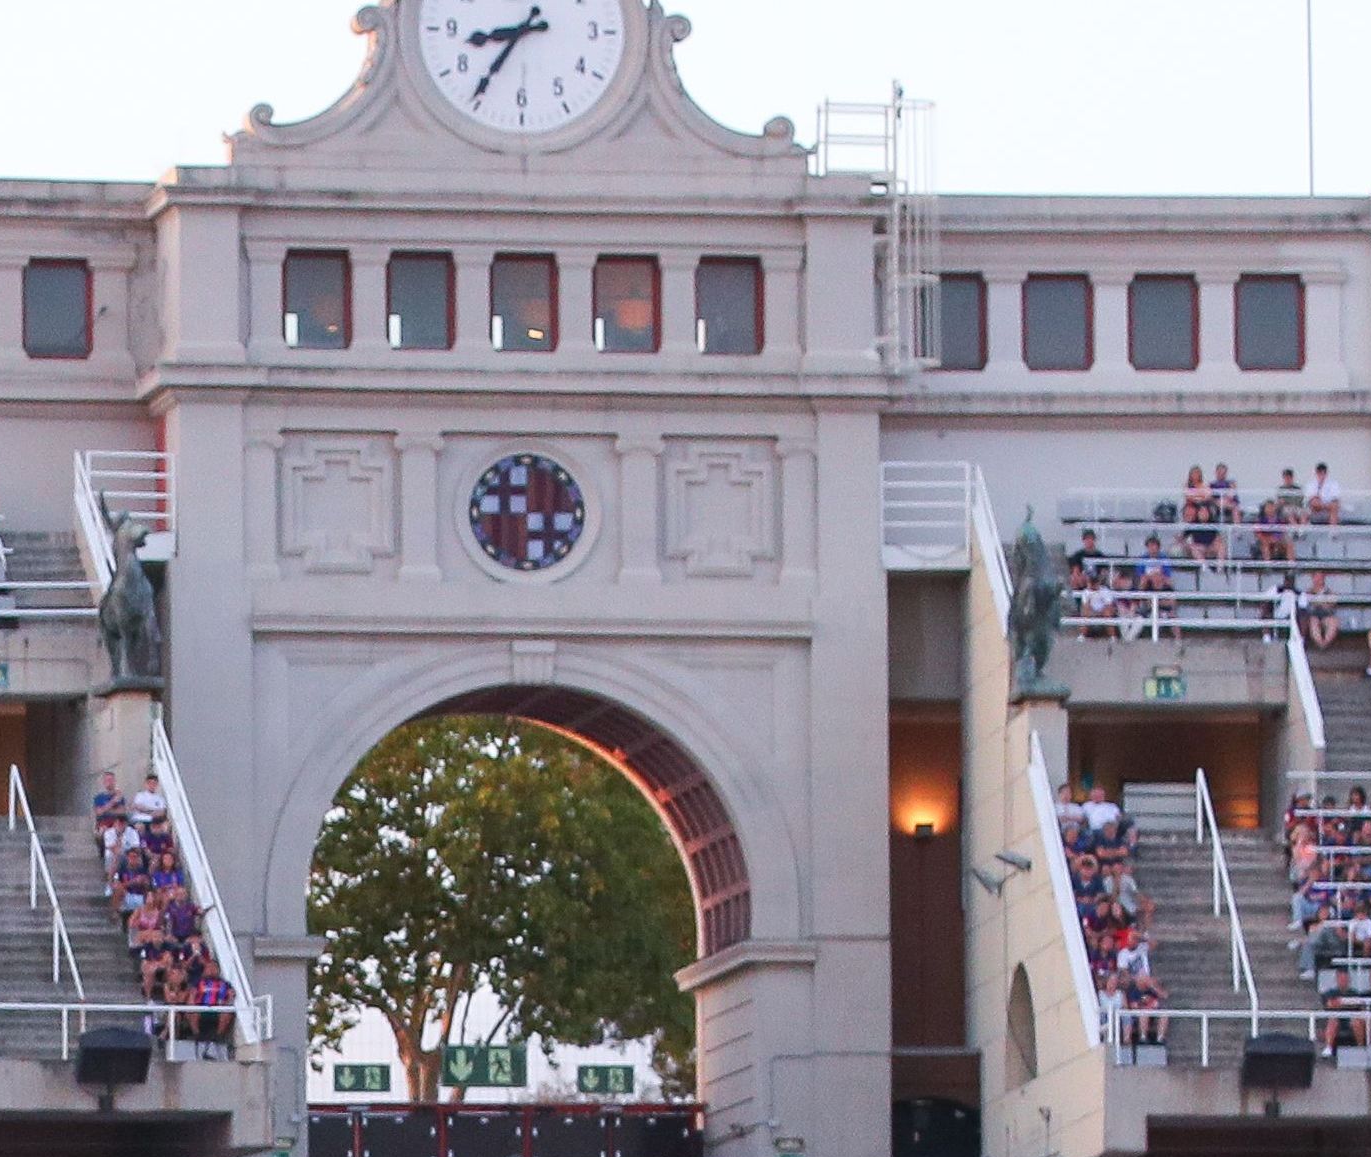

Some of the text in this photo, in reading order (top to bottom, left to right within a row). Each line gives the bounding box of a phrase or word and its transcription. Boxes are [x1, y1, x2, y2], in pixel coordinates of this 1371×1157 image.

[445, 20, 458, 37] 9
[588, 21, 599, 41] 3
[575, 56, 586, 75] 4
